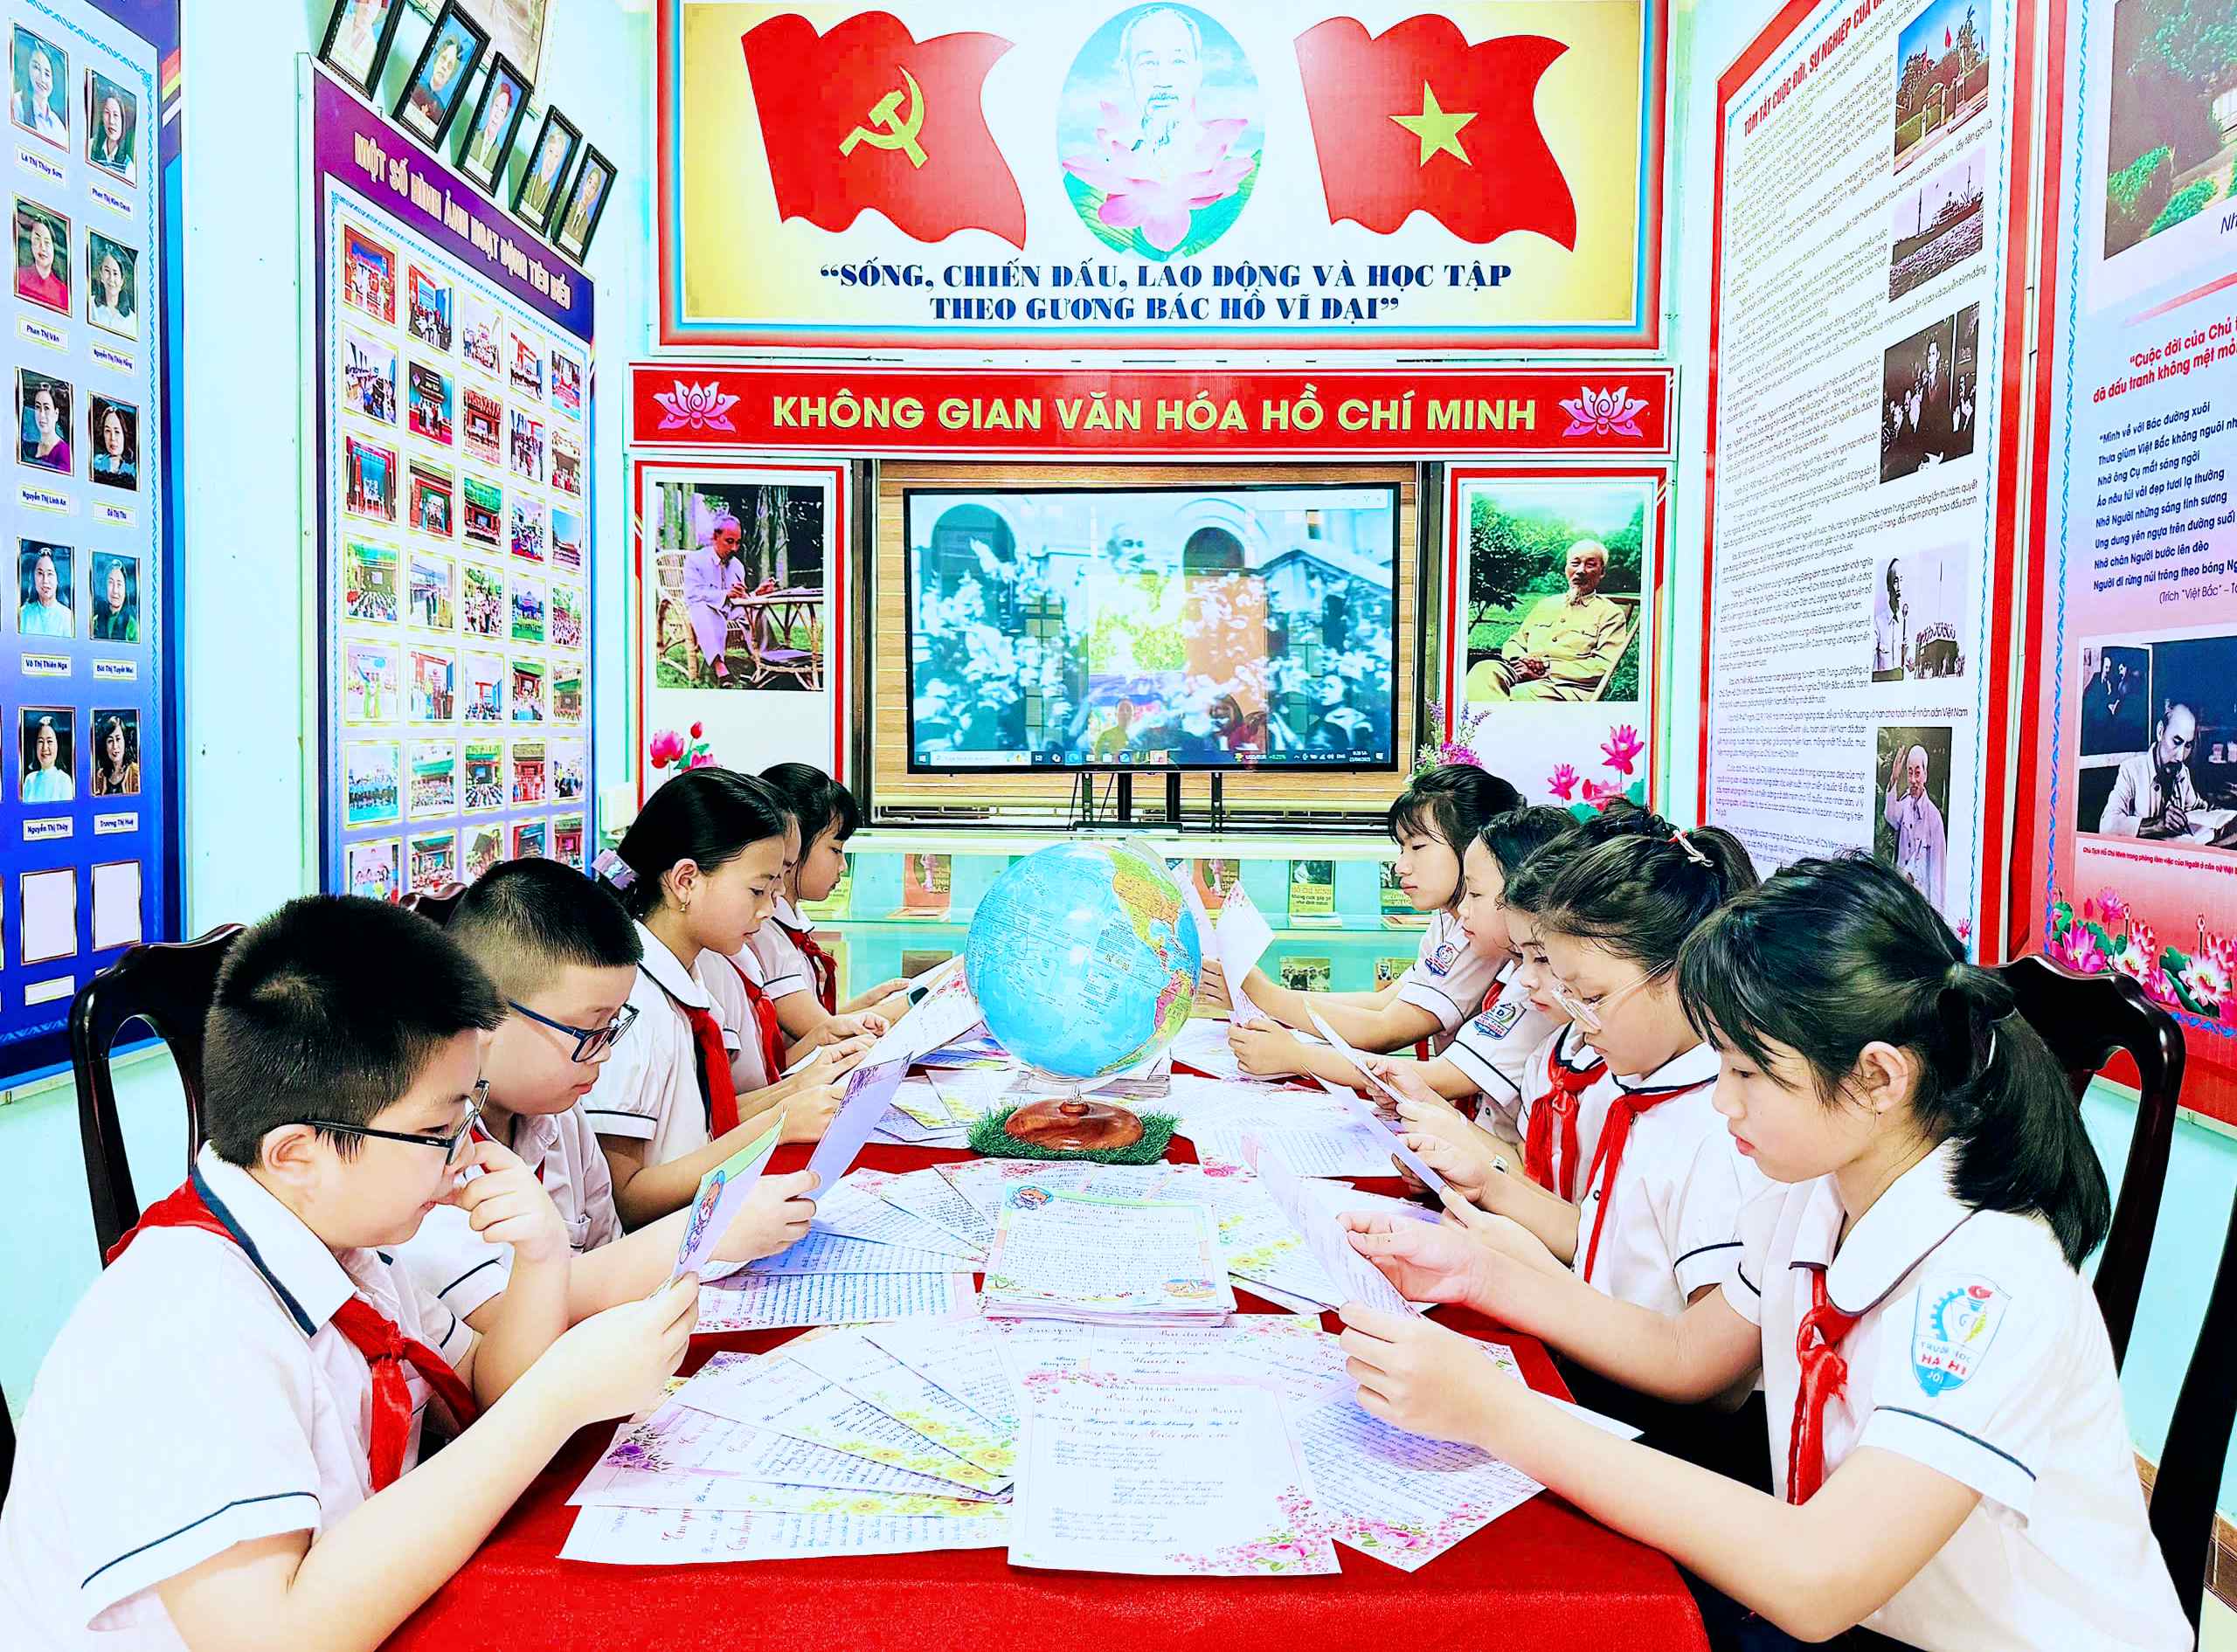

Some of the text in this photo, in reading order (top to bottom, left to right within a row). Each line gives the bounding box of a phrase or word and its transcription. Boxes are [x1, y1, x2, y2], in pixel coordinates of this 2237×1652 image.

[354, 131, 386, 183] MỘT
[389, 157, 409, 197] SỐ
[943, 257, 1041, 287] CHIẾN
[1138, 265, 1202, 287] LAO
[1312, 260, 1357, 287] VÀ
[1367, 265, 1435, 292] HỌC
[1444, 260, 1512, 292] TẬP
[930, 298, 1016, 320] THEO
[1146, 292, 1209, 320] BÁC
[1219, 288, 1265, 320] HỒ
[1277, 294, 1311, 320] VĨ
[2164, 337, 2181, 357] đời
[2184, 329, 2206, 349] của
[2208, 316, 2231, 341] Chủ
[2093, 386, 2106, 404] đã
[2108, 377, 2127, 398] đấu
[2130, 370, 2155, 391] tranh
[2157, 359, 2191, 381] không
[2193, 348, 2215, 369] mệt
[773, 384, 1535, 431] KHÔNG GIAN VĂN HÓA HỒ CHÍ MINH
[2146, 418, 2162, 430] Bác
[2164, 410, 2190, 425] đường
[2138, 440, 2153, 455] Việt
[2154, 435, 2170, 450] Bắc
[2172, 431, 2198, 445] không
[2130, 467, 2141, 480] Cụ
[2159, 457, 2179, 470] sáng
[2149, 482, 2165, 496] đẹp
[2184, 476, 2192, 489] lạ
[2194, 469, 2225, 484] thường
[2112, 510, 2134, 526] Người
[2135, 507, 2159, 520] những
[2161, 501, 2181, 515] sáng
[2200, 492, 2227, 506] sương
[2110, 535, 2130, 546] dung
[2131, 530, 2145, 544] yên
[2147, 527, 2167, 541] ngựa
[2169, 522, 2185, 535] trên
[2187, 517, 2215, 531] đường
[2109, 554, 2129, 567] chân
[2130, 550, 2153, 564] Người
[2155, 546, 2176, 559] bước
[2177, 543, 2190, 556] lên
[2192, 540, 2209, 552] đèo
[2094, 577, 2114, 591] Người
[2157, 567, 2179, 581] trông
[2181, 566, 2200, 577] theo
[2201, 562, 2225, 575] bóng
